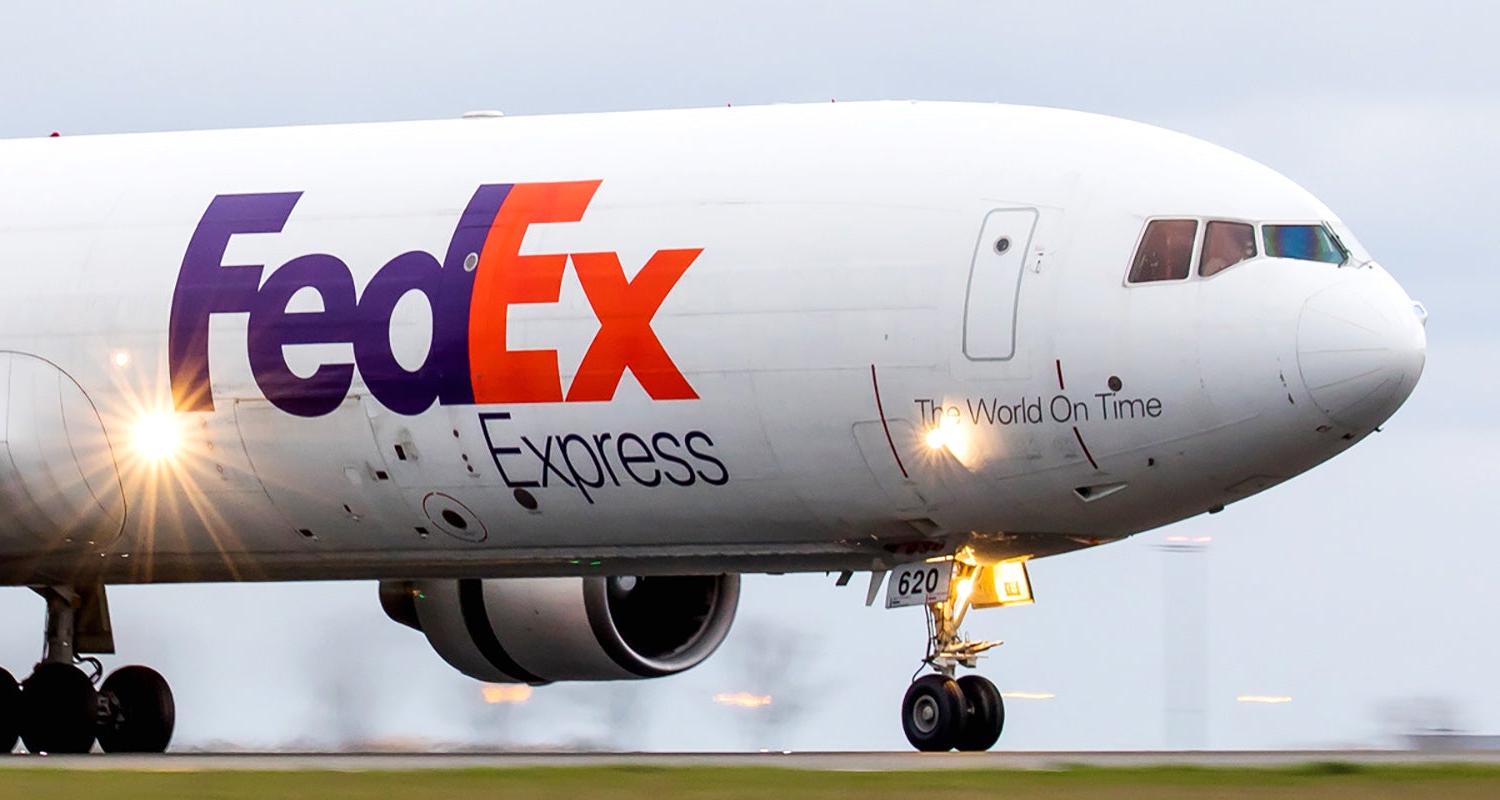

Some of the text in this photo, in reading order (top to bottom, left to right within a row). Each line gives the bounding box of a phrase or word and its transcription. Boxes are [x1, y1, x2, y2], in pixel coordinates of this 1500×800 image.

[169, 179, 705, 417] FedEx
[914, 392, 1163, 427] The World On Time
[478, 412, 729, 504] Express
[898, 567, 939, 596] 620
